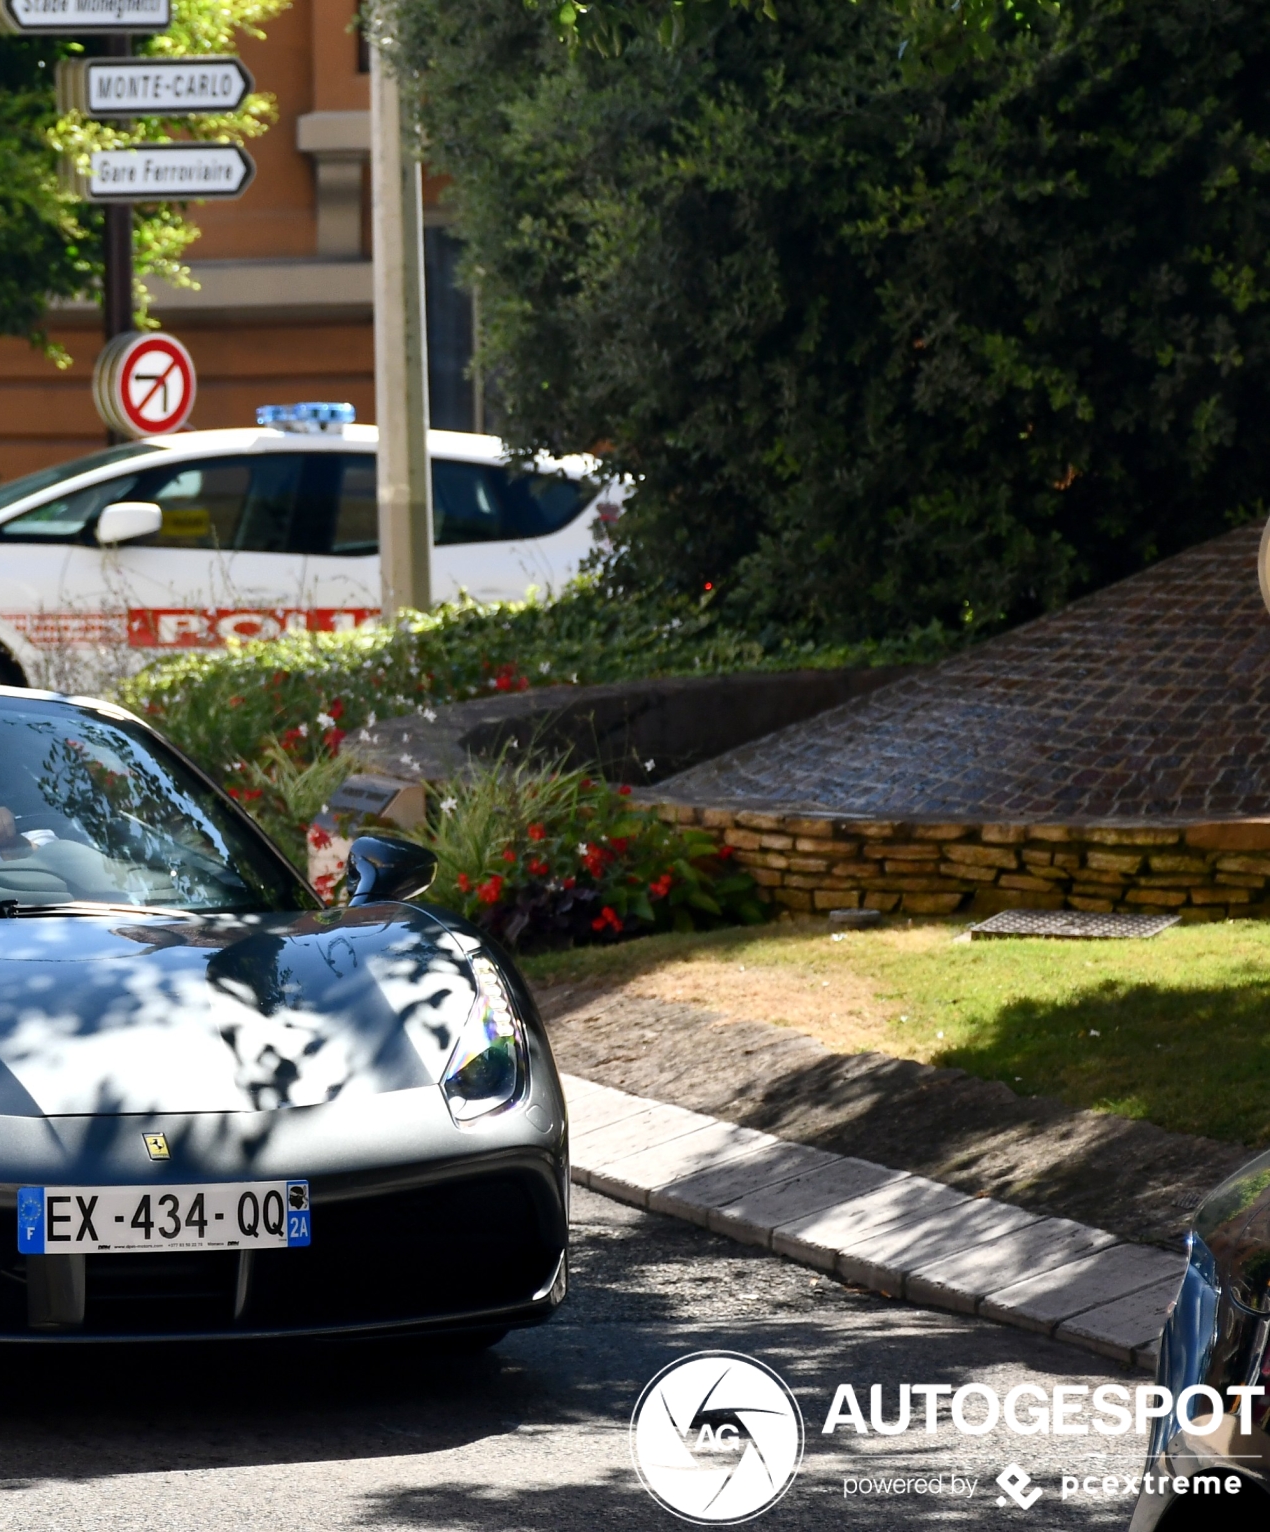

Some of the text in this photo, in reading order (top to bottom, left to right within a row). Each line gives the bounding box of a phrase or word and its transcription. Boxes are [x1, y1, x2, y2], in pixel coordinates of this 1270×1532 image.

[96, 74, 232, 98] MONTE-CARLO
[99, 158, 233, 182] Gare Ferroviaire
[27, 1227, 36, 1240] F
[290, 1217, 309, 1238] 2A
